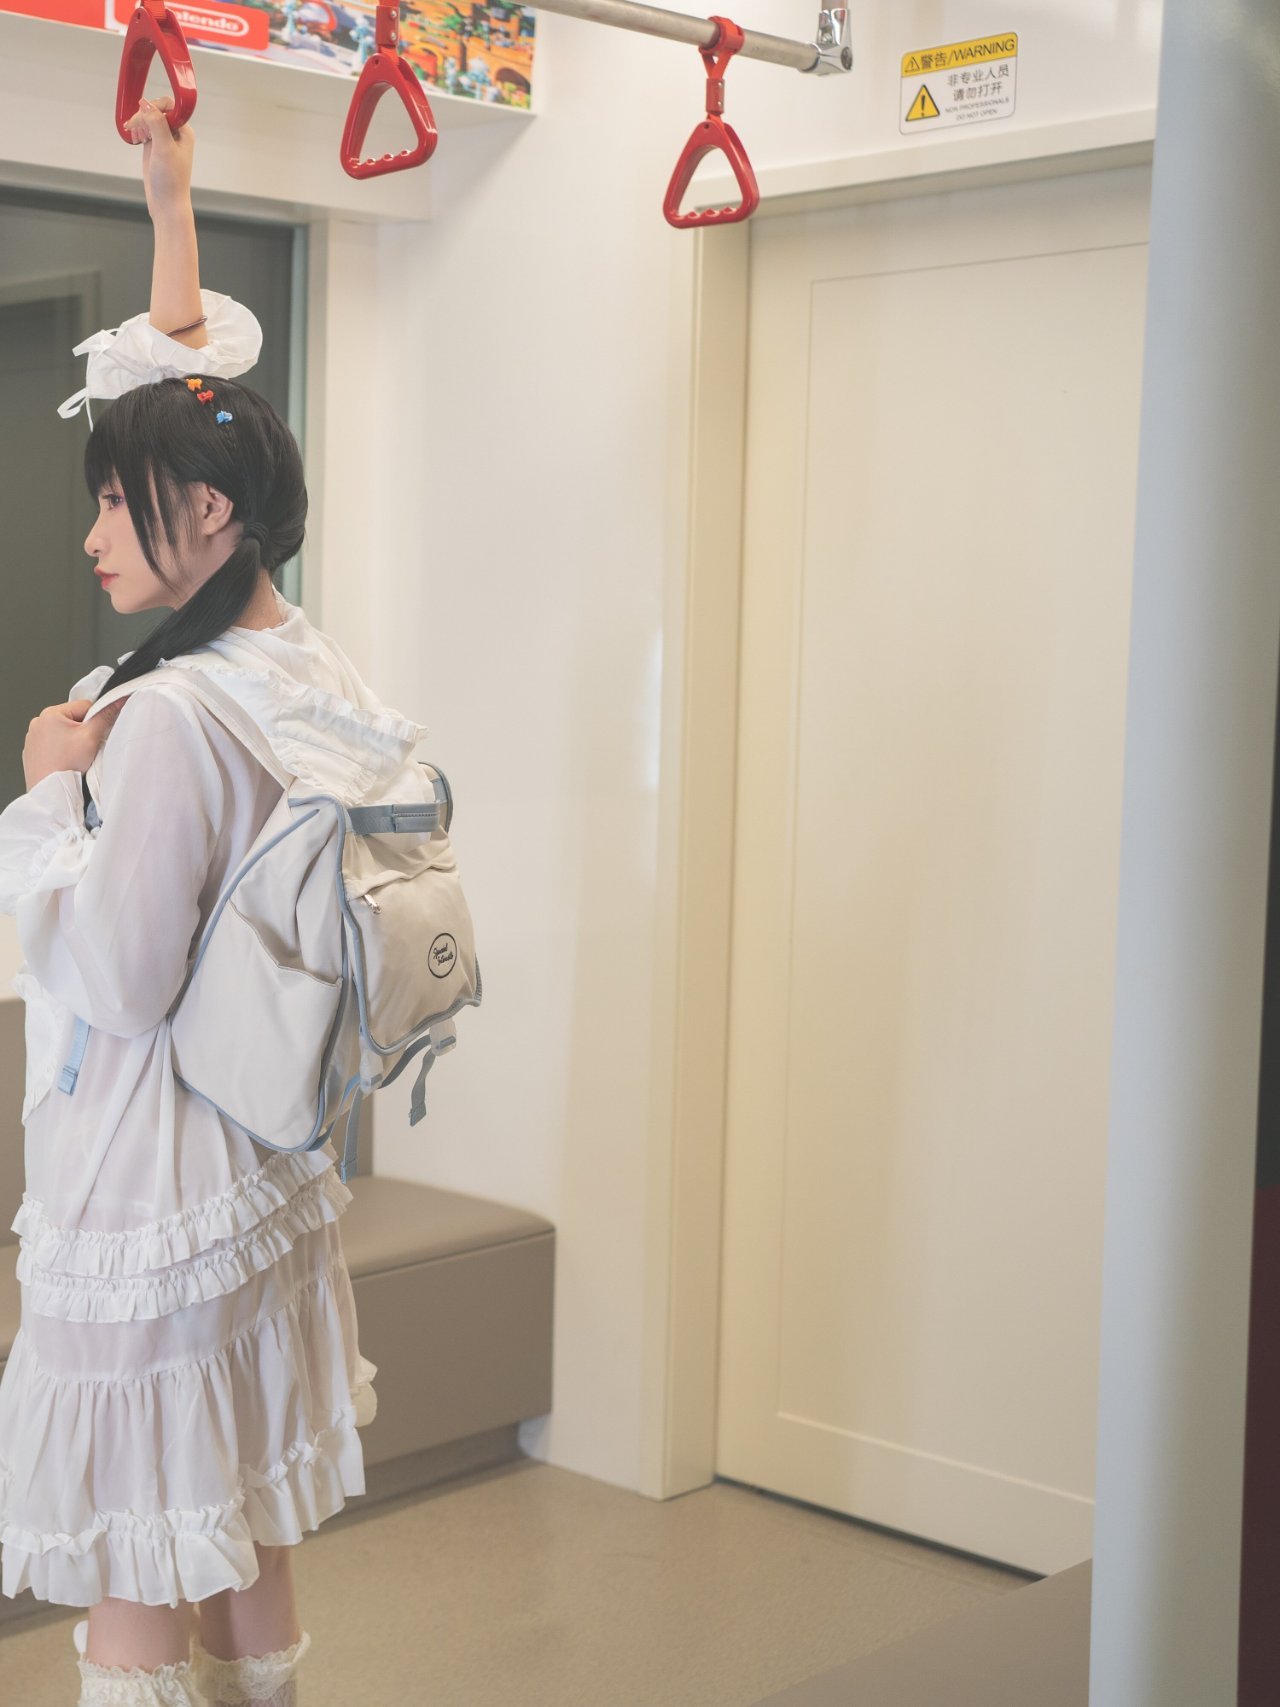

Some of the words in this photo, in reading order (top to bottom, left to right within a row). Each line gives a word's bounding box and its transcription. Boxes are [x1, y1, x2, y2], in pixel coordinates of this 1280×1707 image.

[947, 63, 1009, 87] 非专业人员
[953, 81, 1003, 101] 请勿打开
